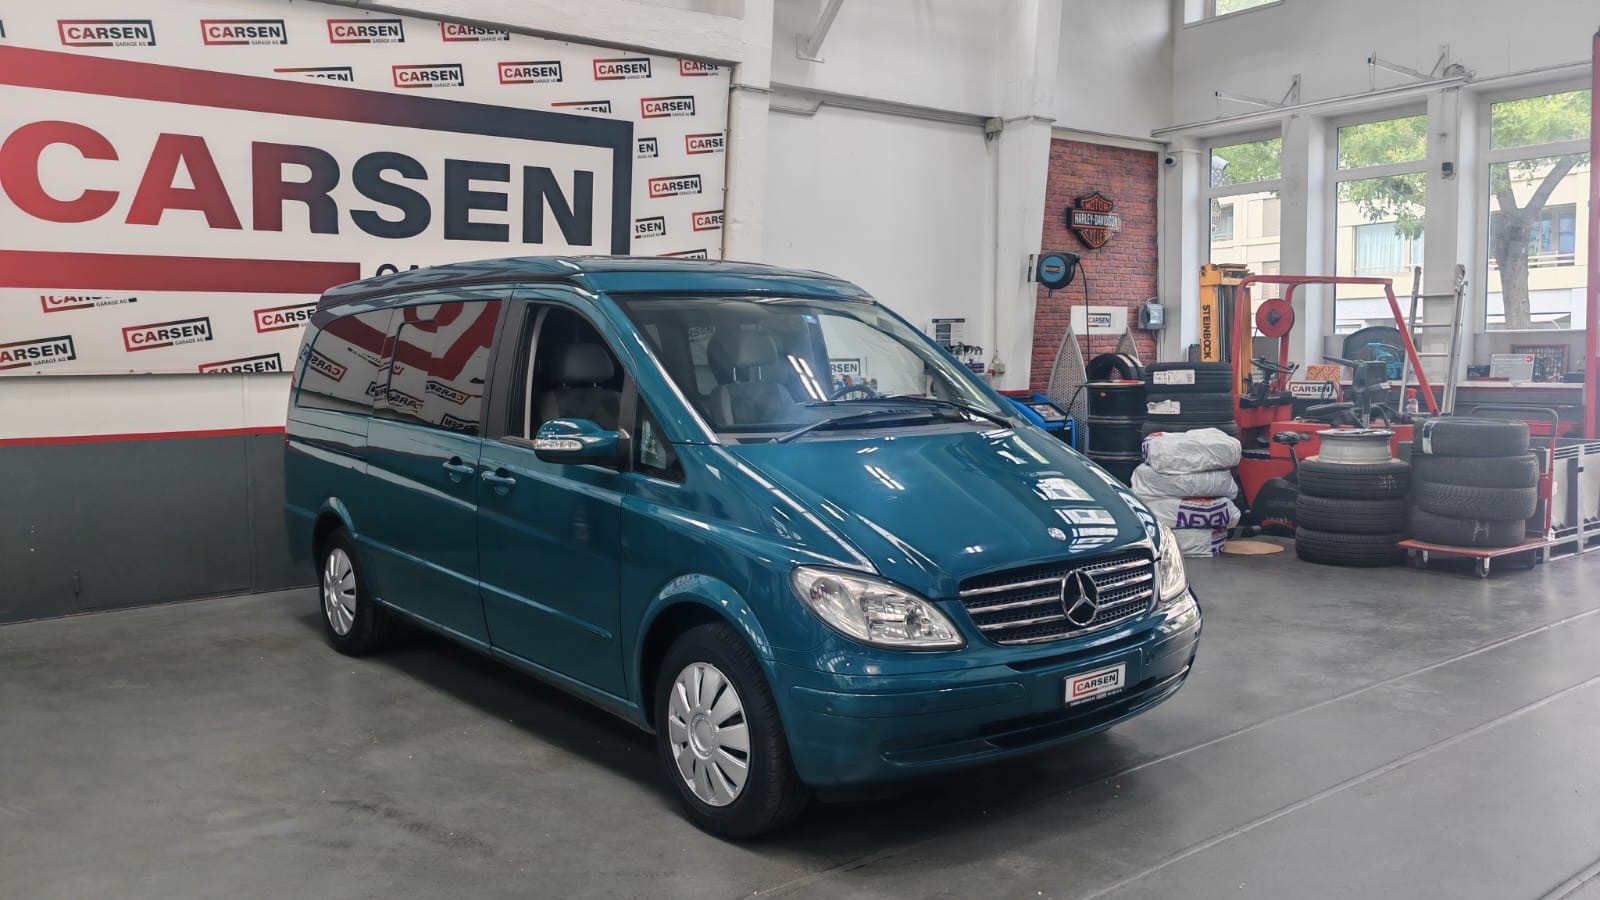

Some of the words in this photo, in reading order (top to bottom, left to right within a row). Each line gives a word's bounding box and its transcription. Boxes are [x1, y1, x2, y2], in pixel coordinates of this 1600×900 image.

[67, 27, 149, 39] CARSEN
[209, 26, 281, 38] CARSEN
[335, 26, 399, 37] CARSEN
[504, 67, 557, 78] CARSEN
[598, 64, 647, 74] CARSEN
[399, 70, 459, 81] CARSEN
[646, 101, 691, 112] CARSEN
[0, 120, 594, 246] CARSEN
[653, 181, 698, 192] CARSEN
[131, 324, 205, 344] CARSEN
[1203, 305, 1212, 359] STEINBOCK
[0, 343, 68, 363] ARSEN
[831, 363, 858, 373] RSEN
[1176, 508, 1229, 528] NEXEN
[1077, 674, 1116, 692] CARSEN
